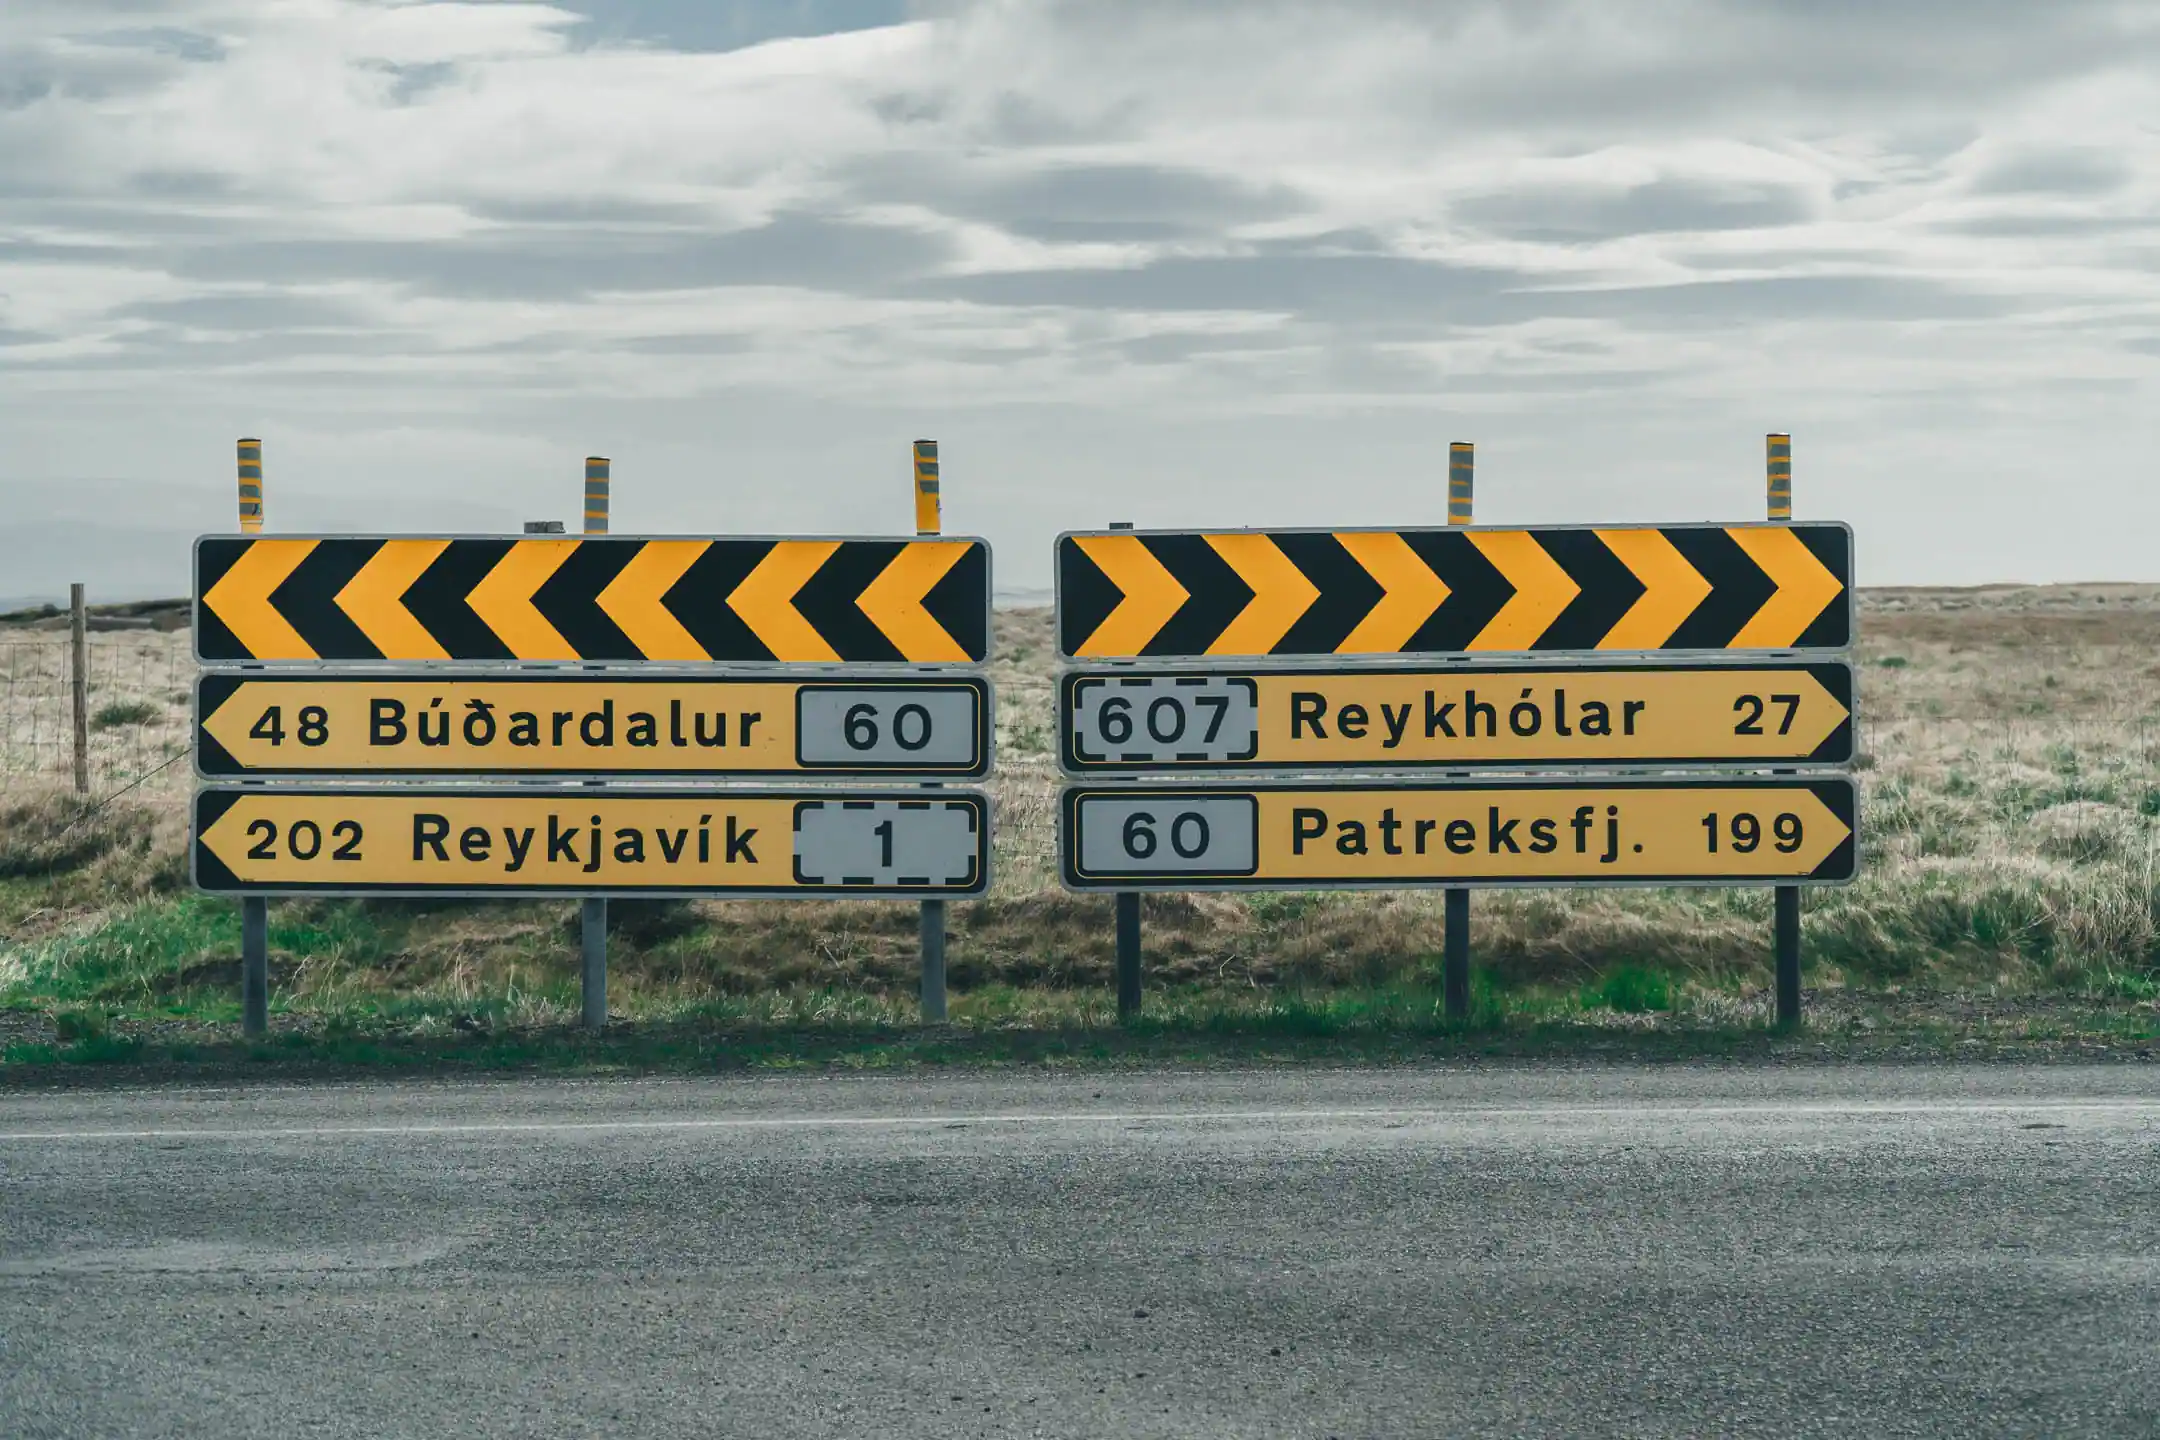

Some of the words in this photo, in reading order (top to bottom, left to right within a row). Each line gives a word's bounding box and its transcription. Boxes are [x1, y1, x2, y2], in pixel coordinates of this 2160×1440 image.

[250, 705, 329, 747] 48
[369, 697, 762, 748] Búðardalur
[843, 703, 933, 752] 60
[1098, 695, 1230, 745] 607
[1290, 687, 1645, 749] Reykhólar
[1733, 694, 1801, 736] 27
[246, 819, 364, 861] 202
[412, 813, 759, 873] Reykjavík
[873, 819, 893, 868] 1
[1122, 811, 1211, 860] 60
[1292, 804, 1643, 864] Patreksfj.
[1701, 812, 1804, 854] 199
